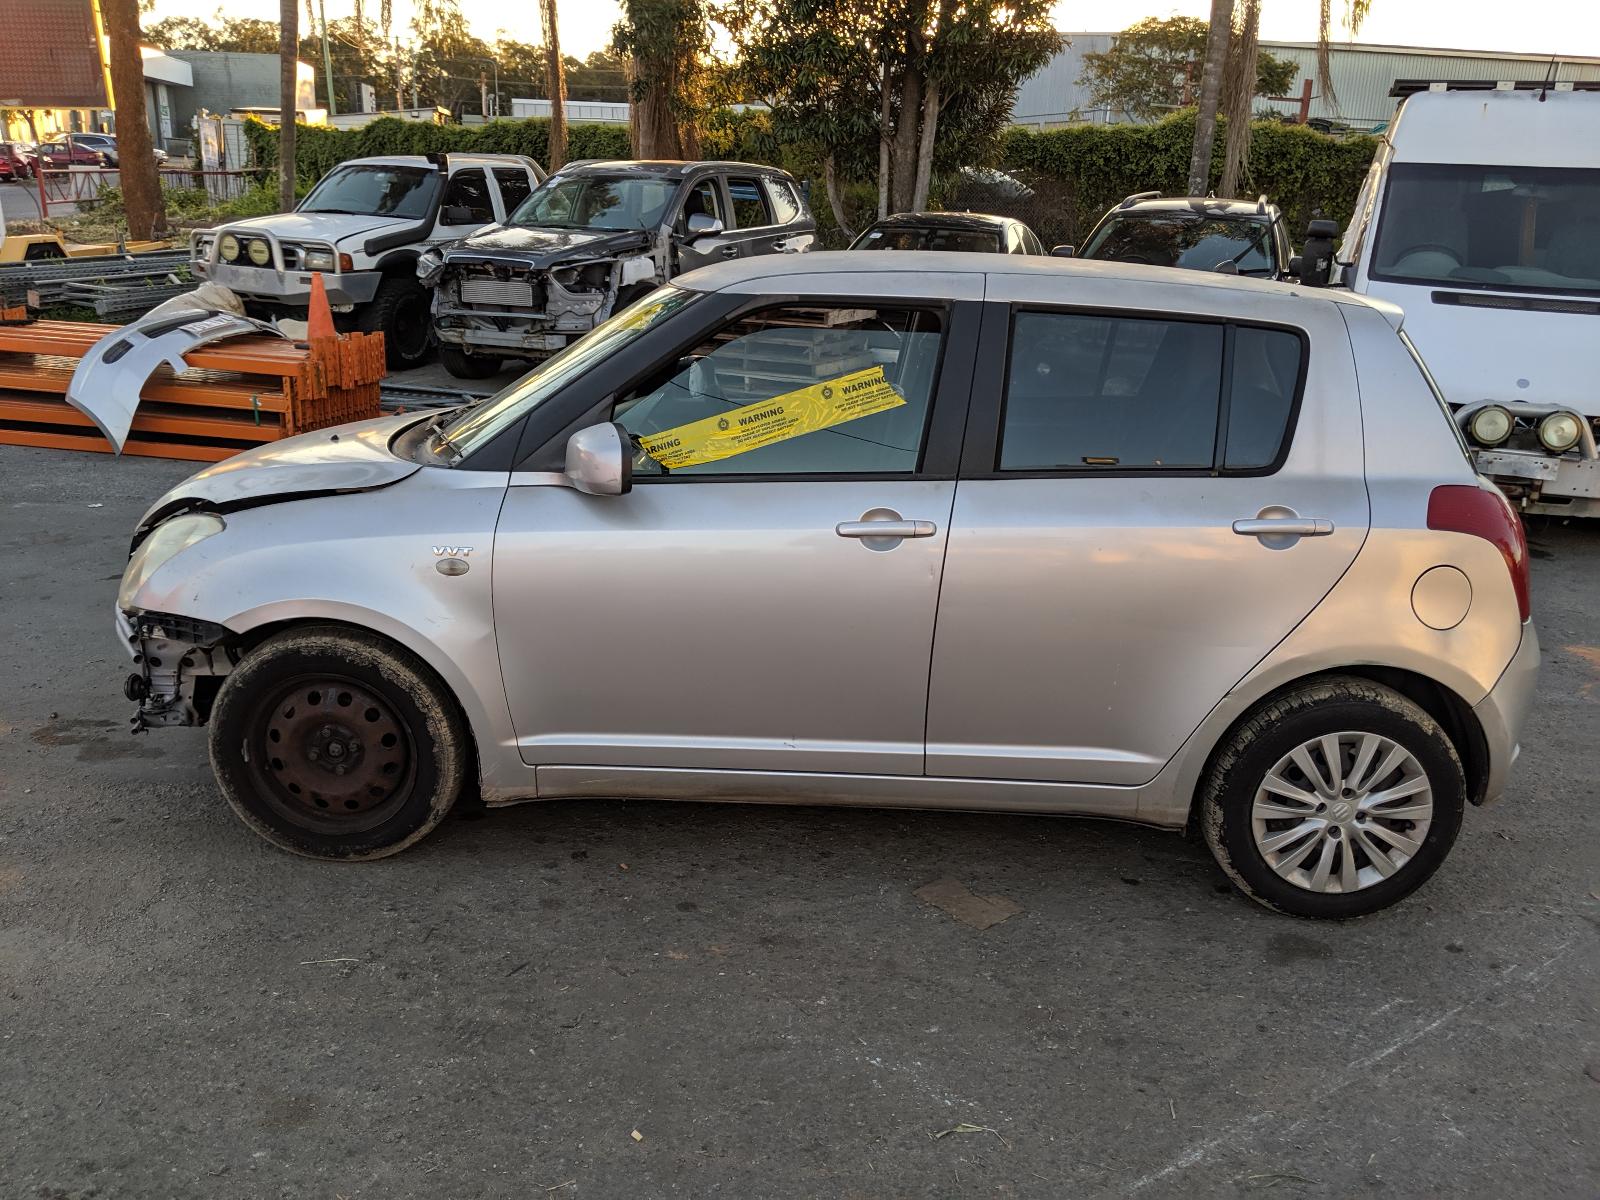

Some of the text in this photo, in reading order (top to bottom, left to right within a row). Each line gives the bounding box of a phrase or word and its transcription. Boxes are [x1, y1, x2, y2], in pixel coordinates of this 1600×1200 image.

[738, 406, 785, 426] WARNING
[645, 438, 681, 455] ARNING
[432, 545, 473, 556] VVT
